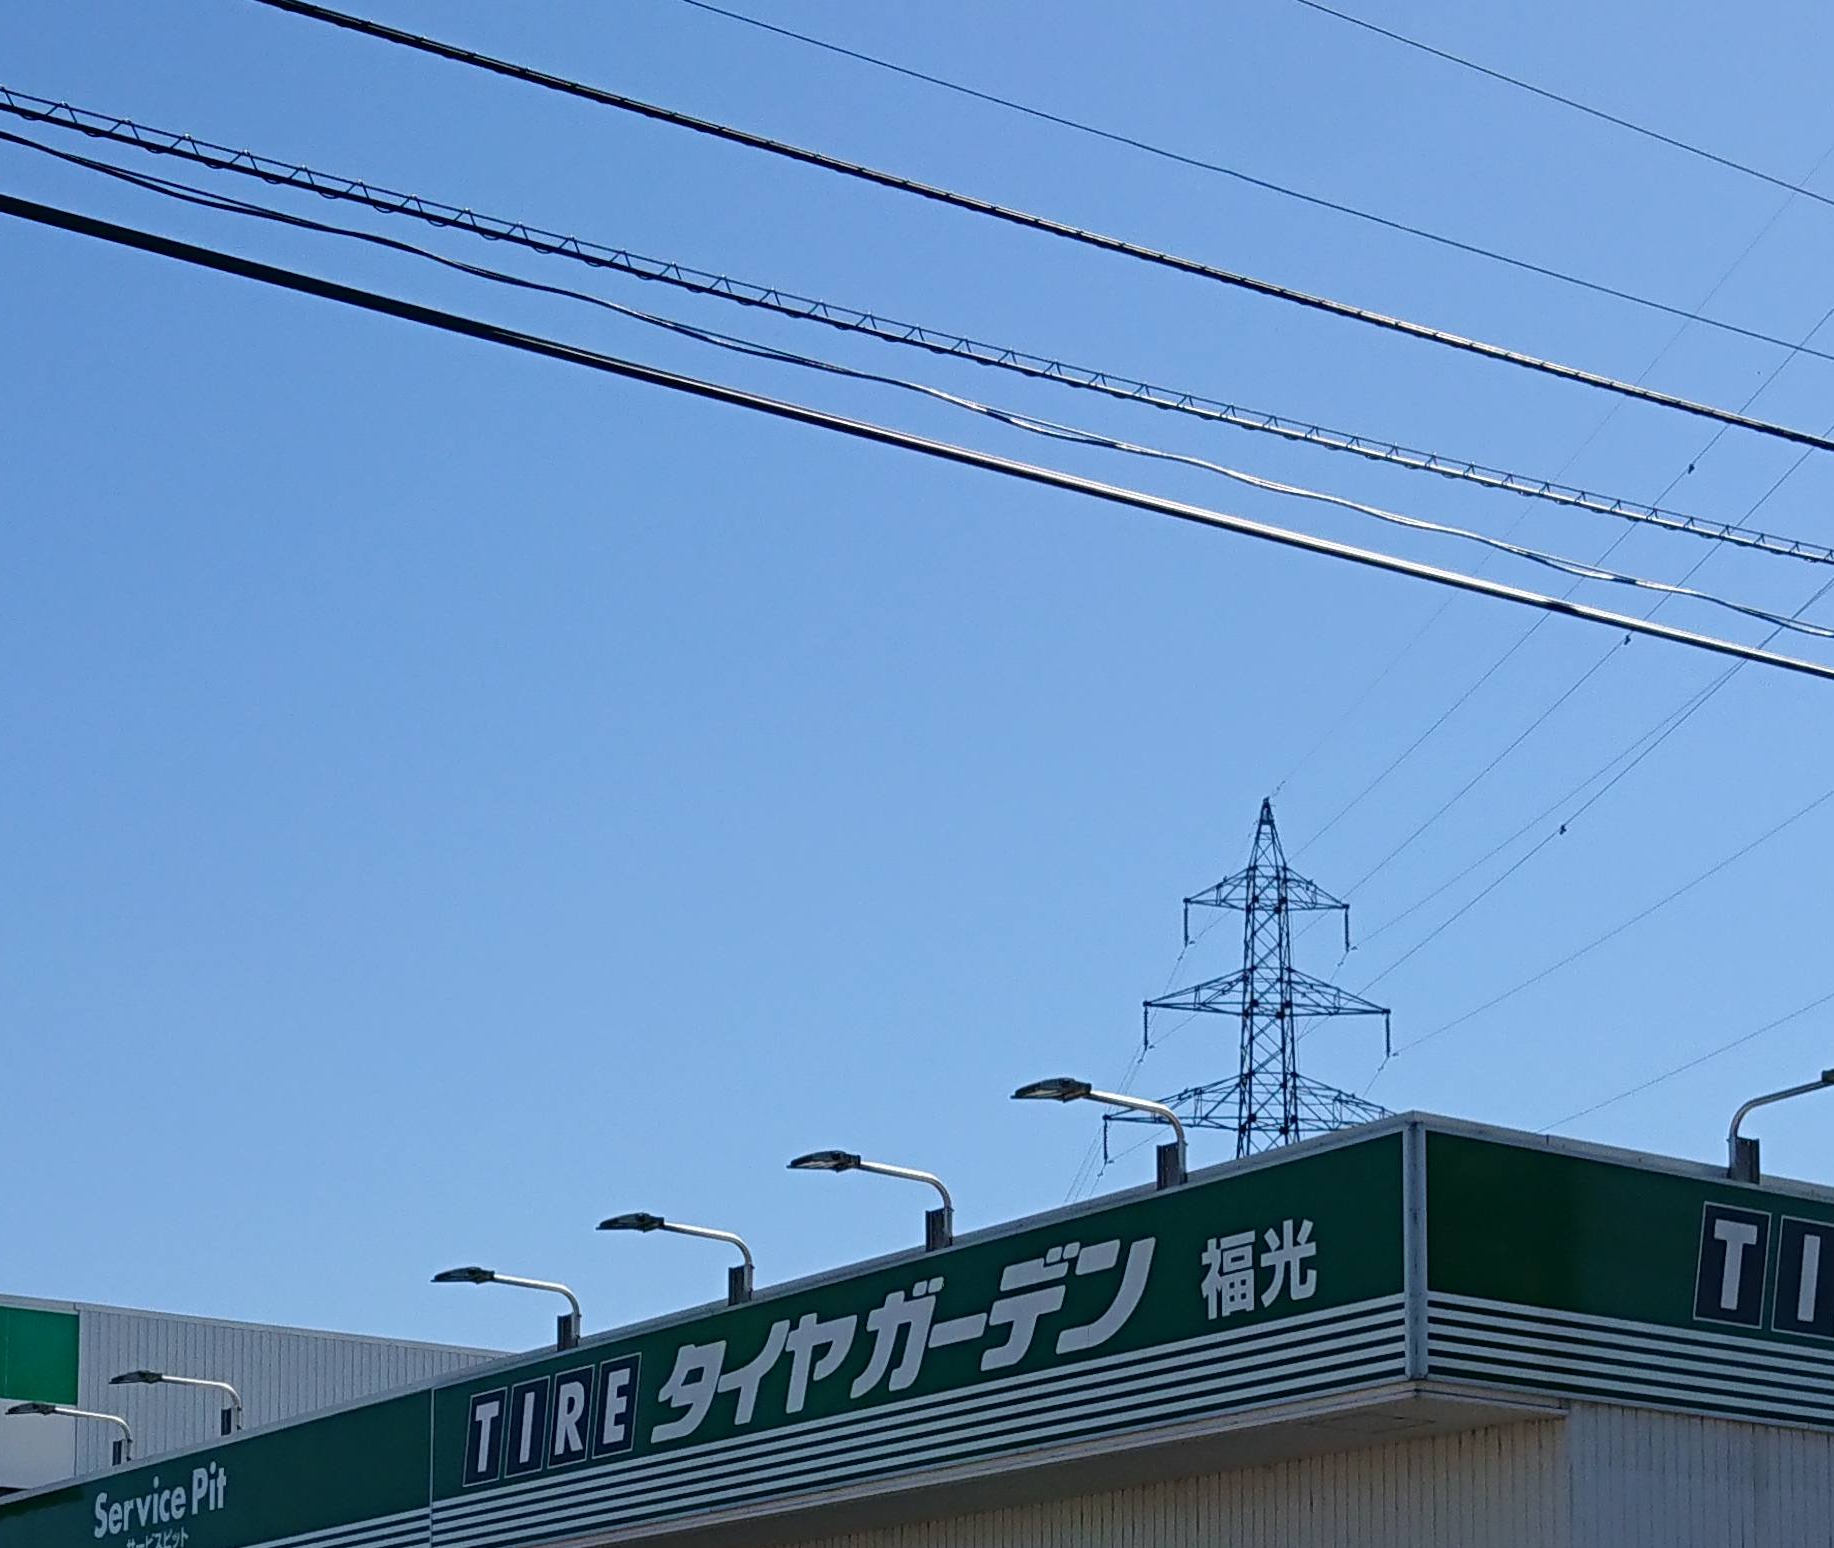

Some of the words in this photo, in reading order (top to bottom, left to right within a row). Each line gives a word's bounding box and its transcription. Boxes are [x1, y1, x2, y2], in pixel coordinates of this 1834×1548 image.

[1201, 1219, 1317, 1319] 福光
[650, 1237, 1156, 1443] タイヤガーデン
[475, 1367, 631, 1473] TIRE
[94, 1475, 187, 1539] Service
[191, 1461, 227, 1515] Pit
